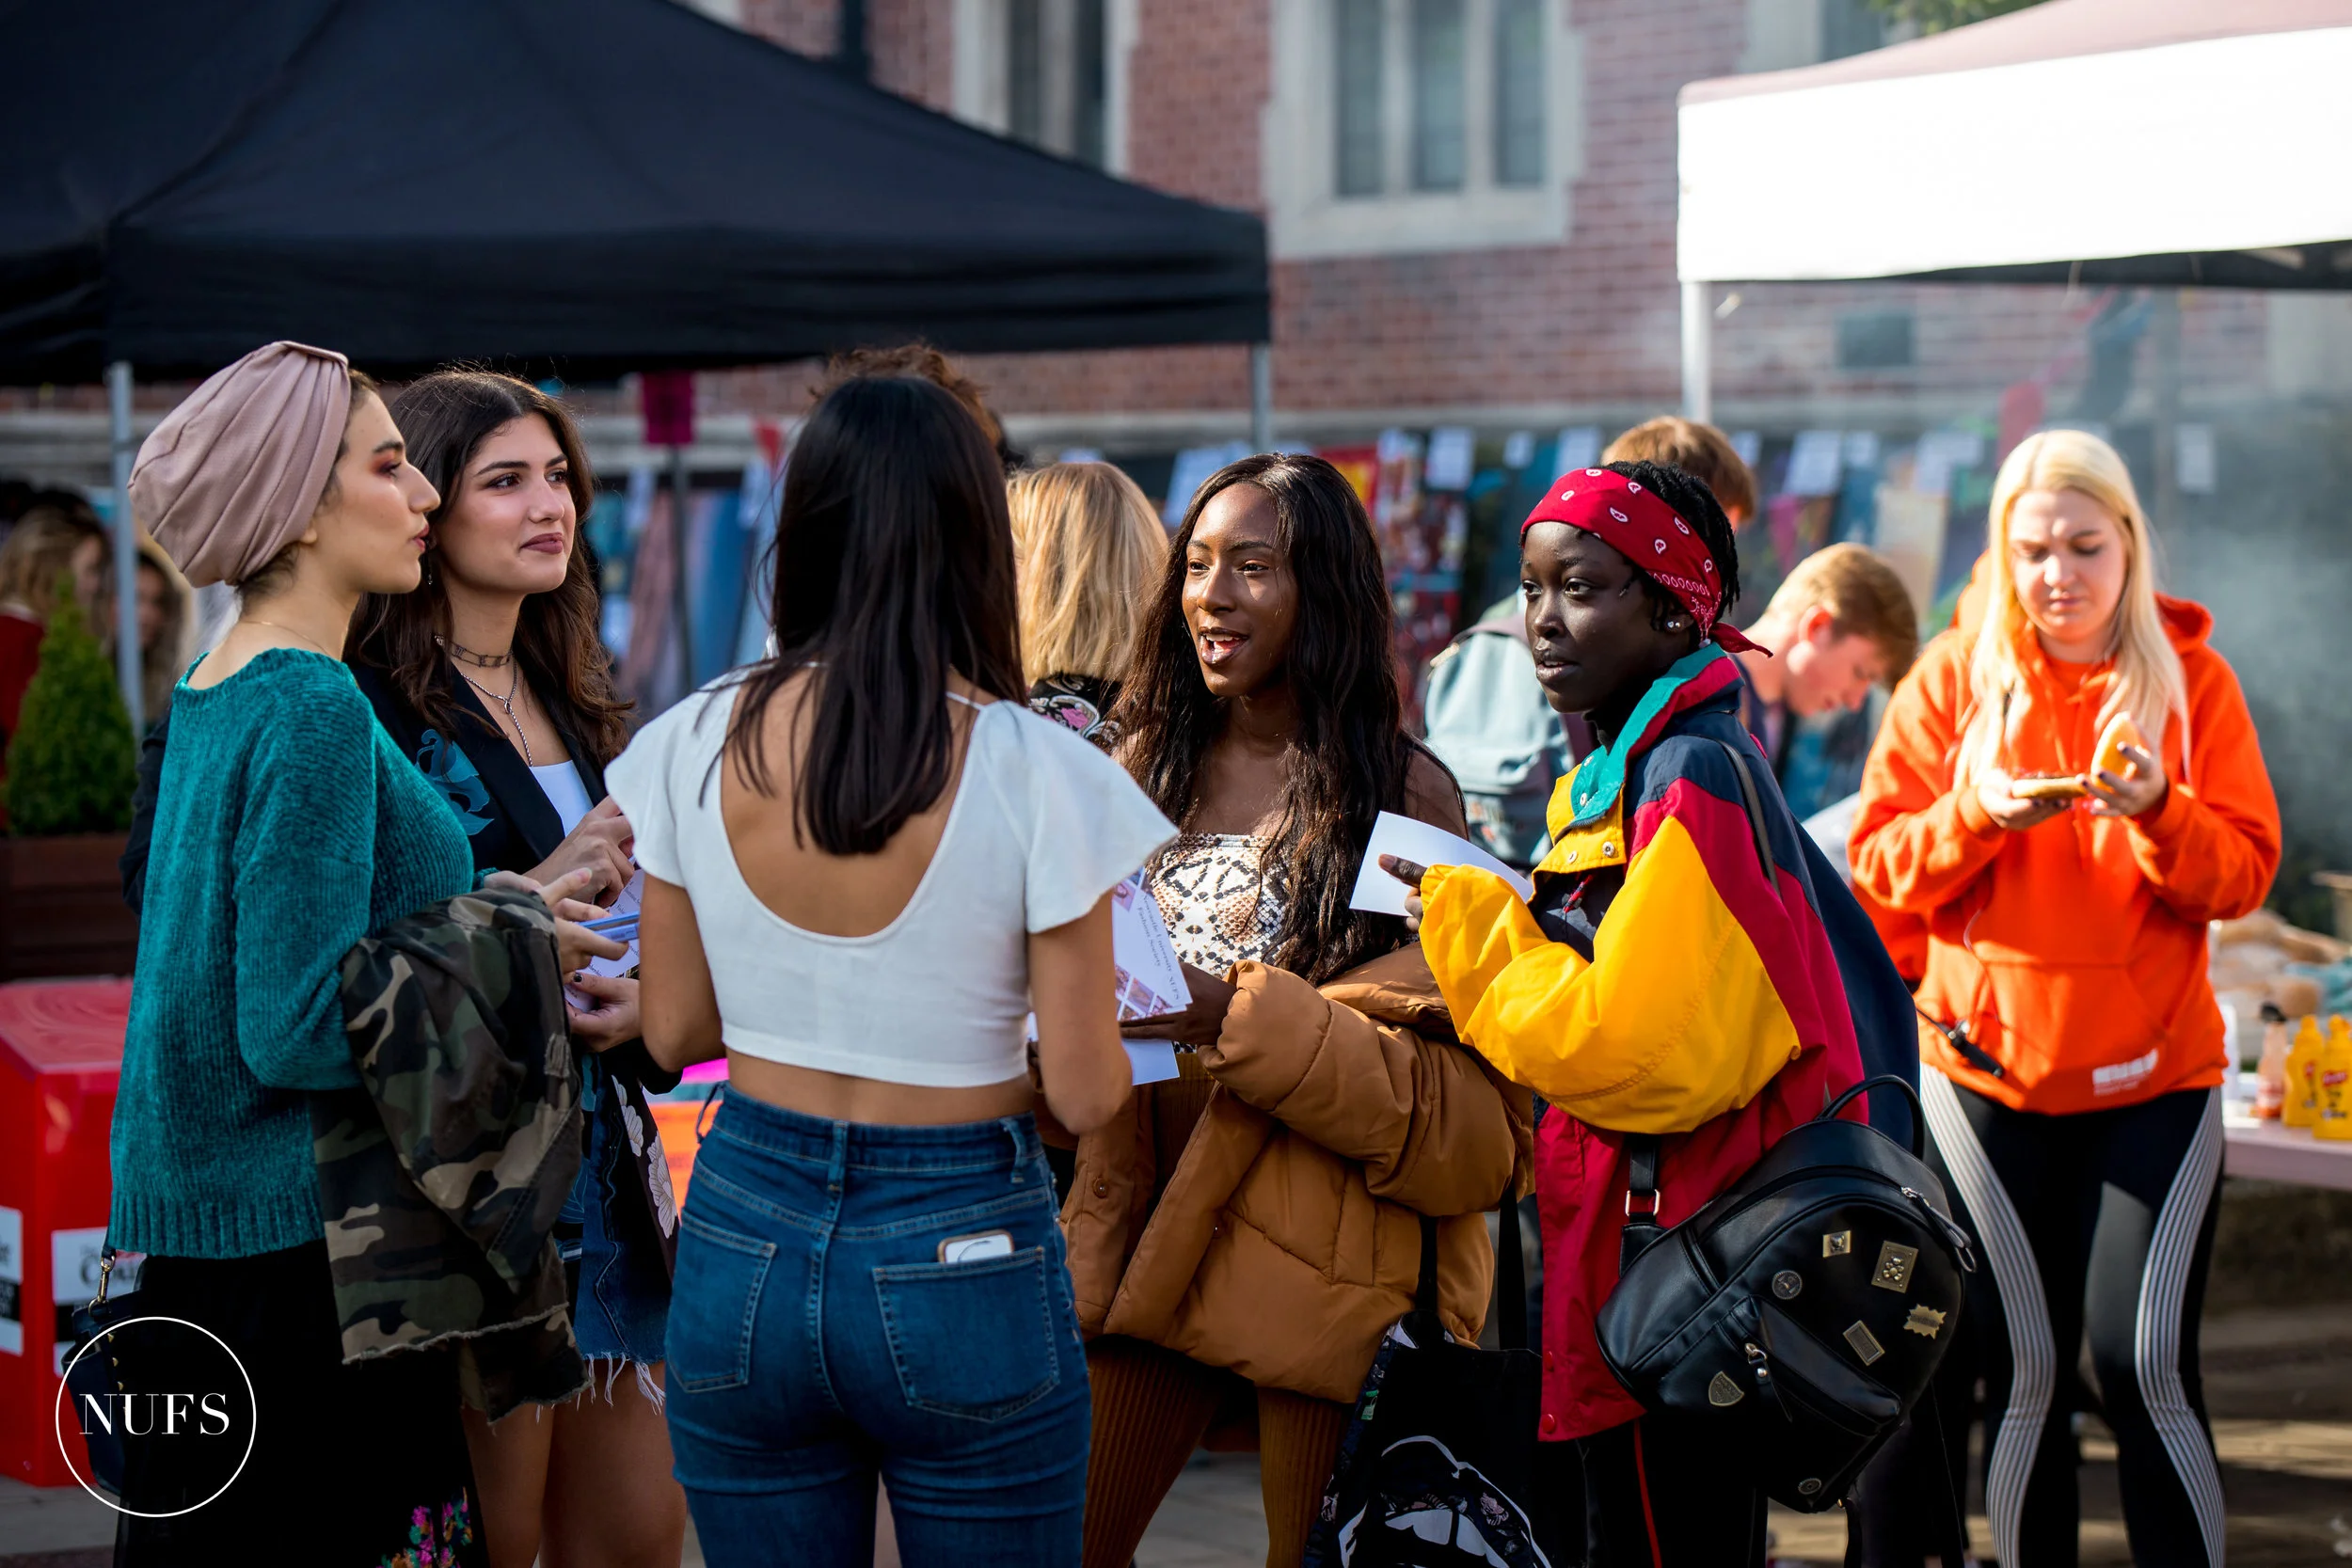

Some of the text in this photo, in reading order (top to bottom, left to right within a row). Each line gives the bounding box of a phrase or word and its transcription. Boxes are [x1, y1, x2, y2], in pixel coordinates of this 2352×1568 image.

[1136, 906, 1161, 967] Fashion Society
[1155, 932, 1172, 972] University
